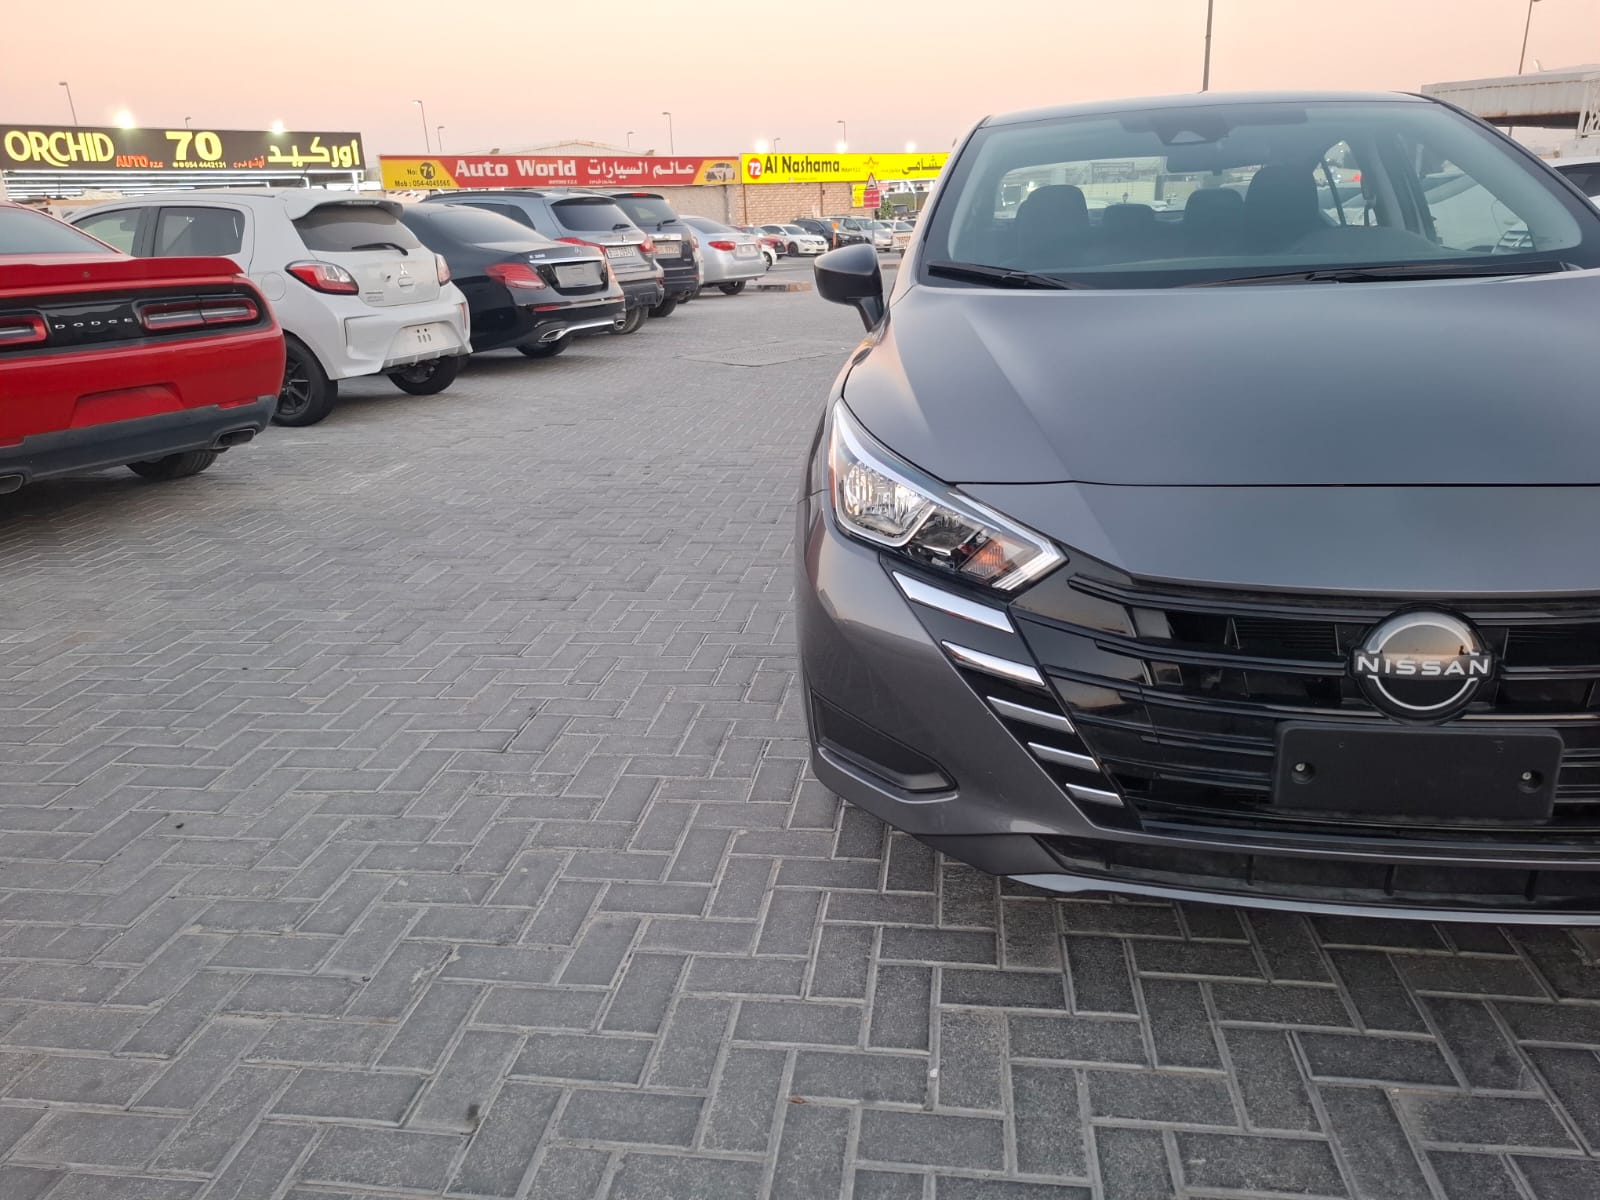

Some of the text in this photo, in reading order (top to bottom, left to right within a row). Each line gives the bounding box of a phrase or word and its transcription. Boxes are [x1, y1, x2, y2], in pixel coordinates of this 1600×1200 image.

[4, 130, 115, 167] ORCHID
[165, 131, 222, 161] 70
[116, 155, 148, 168] AUTO
[455, 160, 577, 177] Auto World
[587, 159, 695, 180] عالم السيارات
[748, 163, 762, 175] 72
[764, 156, 840, 173] Al Nashama
[421, 166, 434, 176] 71
[54, 317, 134, 330] DODGE
[1357, 656, 1489, 676] NISSAN
